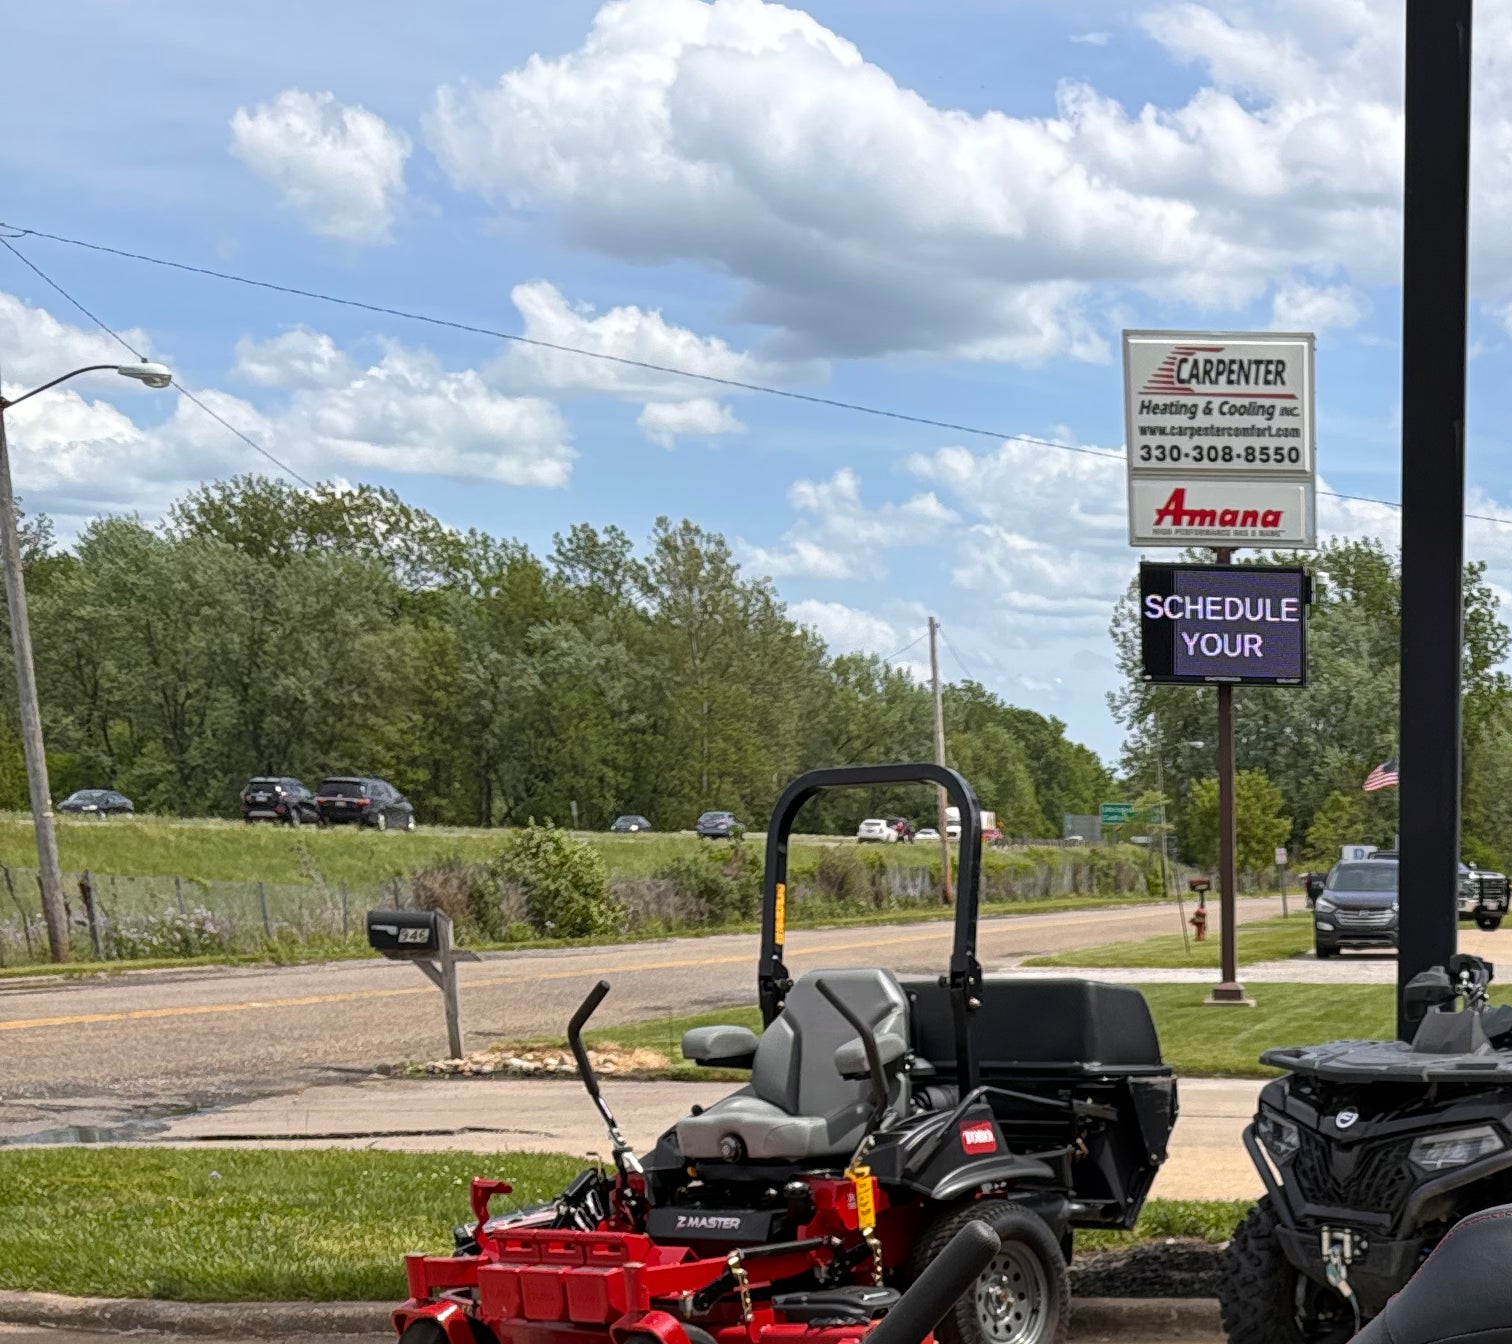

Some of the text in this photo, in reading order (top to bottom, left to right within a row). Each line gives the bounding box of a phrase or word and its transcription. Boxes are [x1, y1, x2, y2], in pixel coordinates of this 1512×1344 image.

[1176, 357, 1286, 386] CARPENTER
[1138, 400, 1198, 420] Heating
[1202, 401, 1213, 416] &
[1218, 401, 1276, 421] Cooling
[1153, 487, 1283, 528] Amana
[1144, 594, 1300, 623] SCHEDULE
[1181, 631, 1264, 658] YOUR
